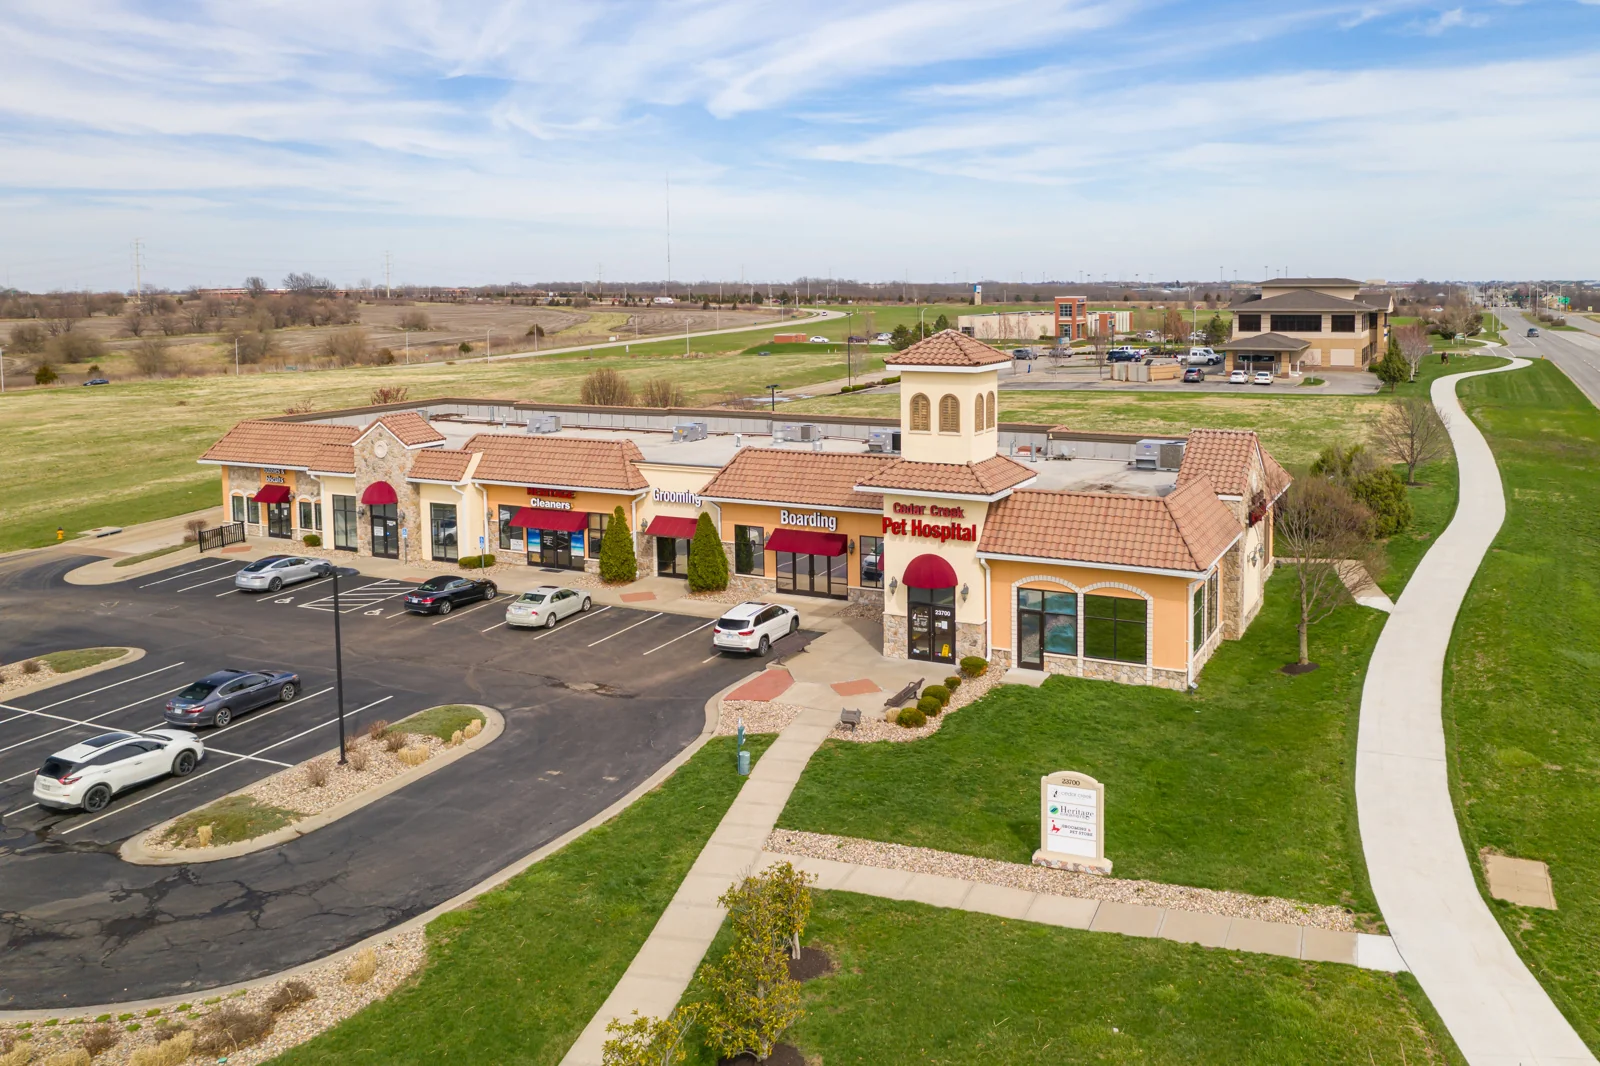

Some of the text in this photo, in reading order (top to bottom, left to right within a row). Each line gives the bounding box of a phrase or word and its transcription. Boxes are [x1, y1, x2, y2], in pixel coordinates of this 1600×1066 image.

[530, 498, 571, 510] Cleaners
[653, 487, 702, 507] Grooming
[893, 502, 965, 519] Cedar Creek
[780, 509, 837, 532] Boarding
[882, 517, 977, 543] Pet Hospital
[935, 609, 951, 617] 23700
[1062, 778, 1080, 786] 23700
[1060, 805, 1094, 820] Heritage
